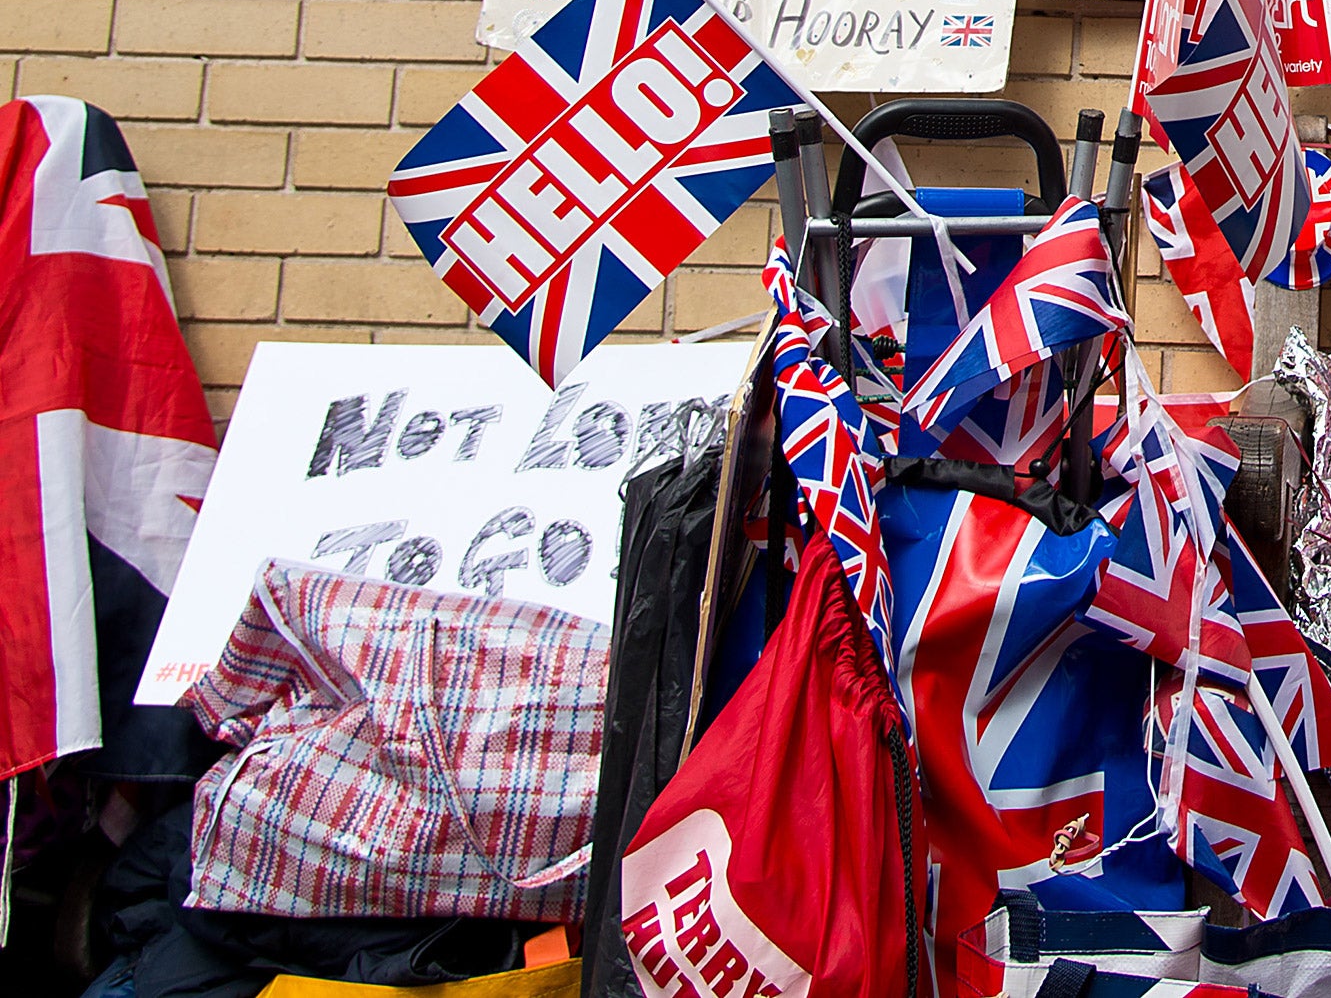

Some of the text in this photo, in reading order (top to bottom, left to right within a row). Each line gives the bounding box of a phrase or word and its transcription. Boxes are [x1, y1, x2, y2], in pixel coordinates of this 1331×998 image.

[1284, 58, 1323, 74] variety
[450, 29, 735, 305] HELLO!
[514, 380, 732, 472] LON
